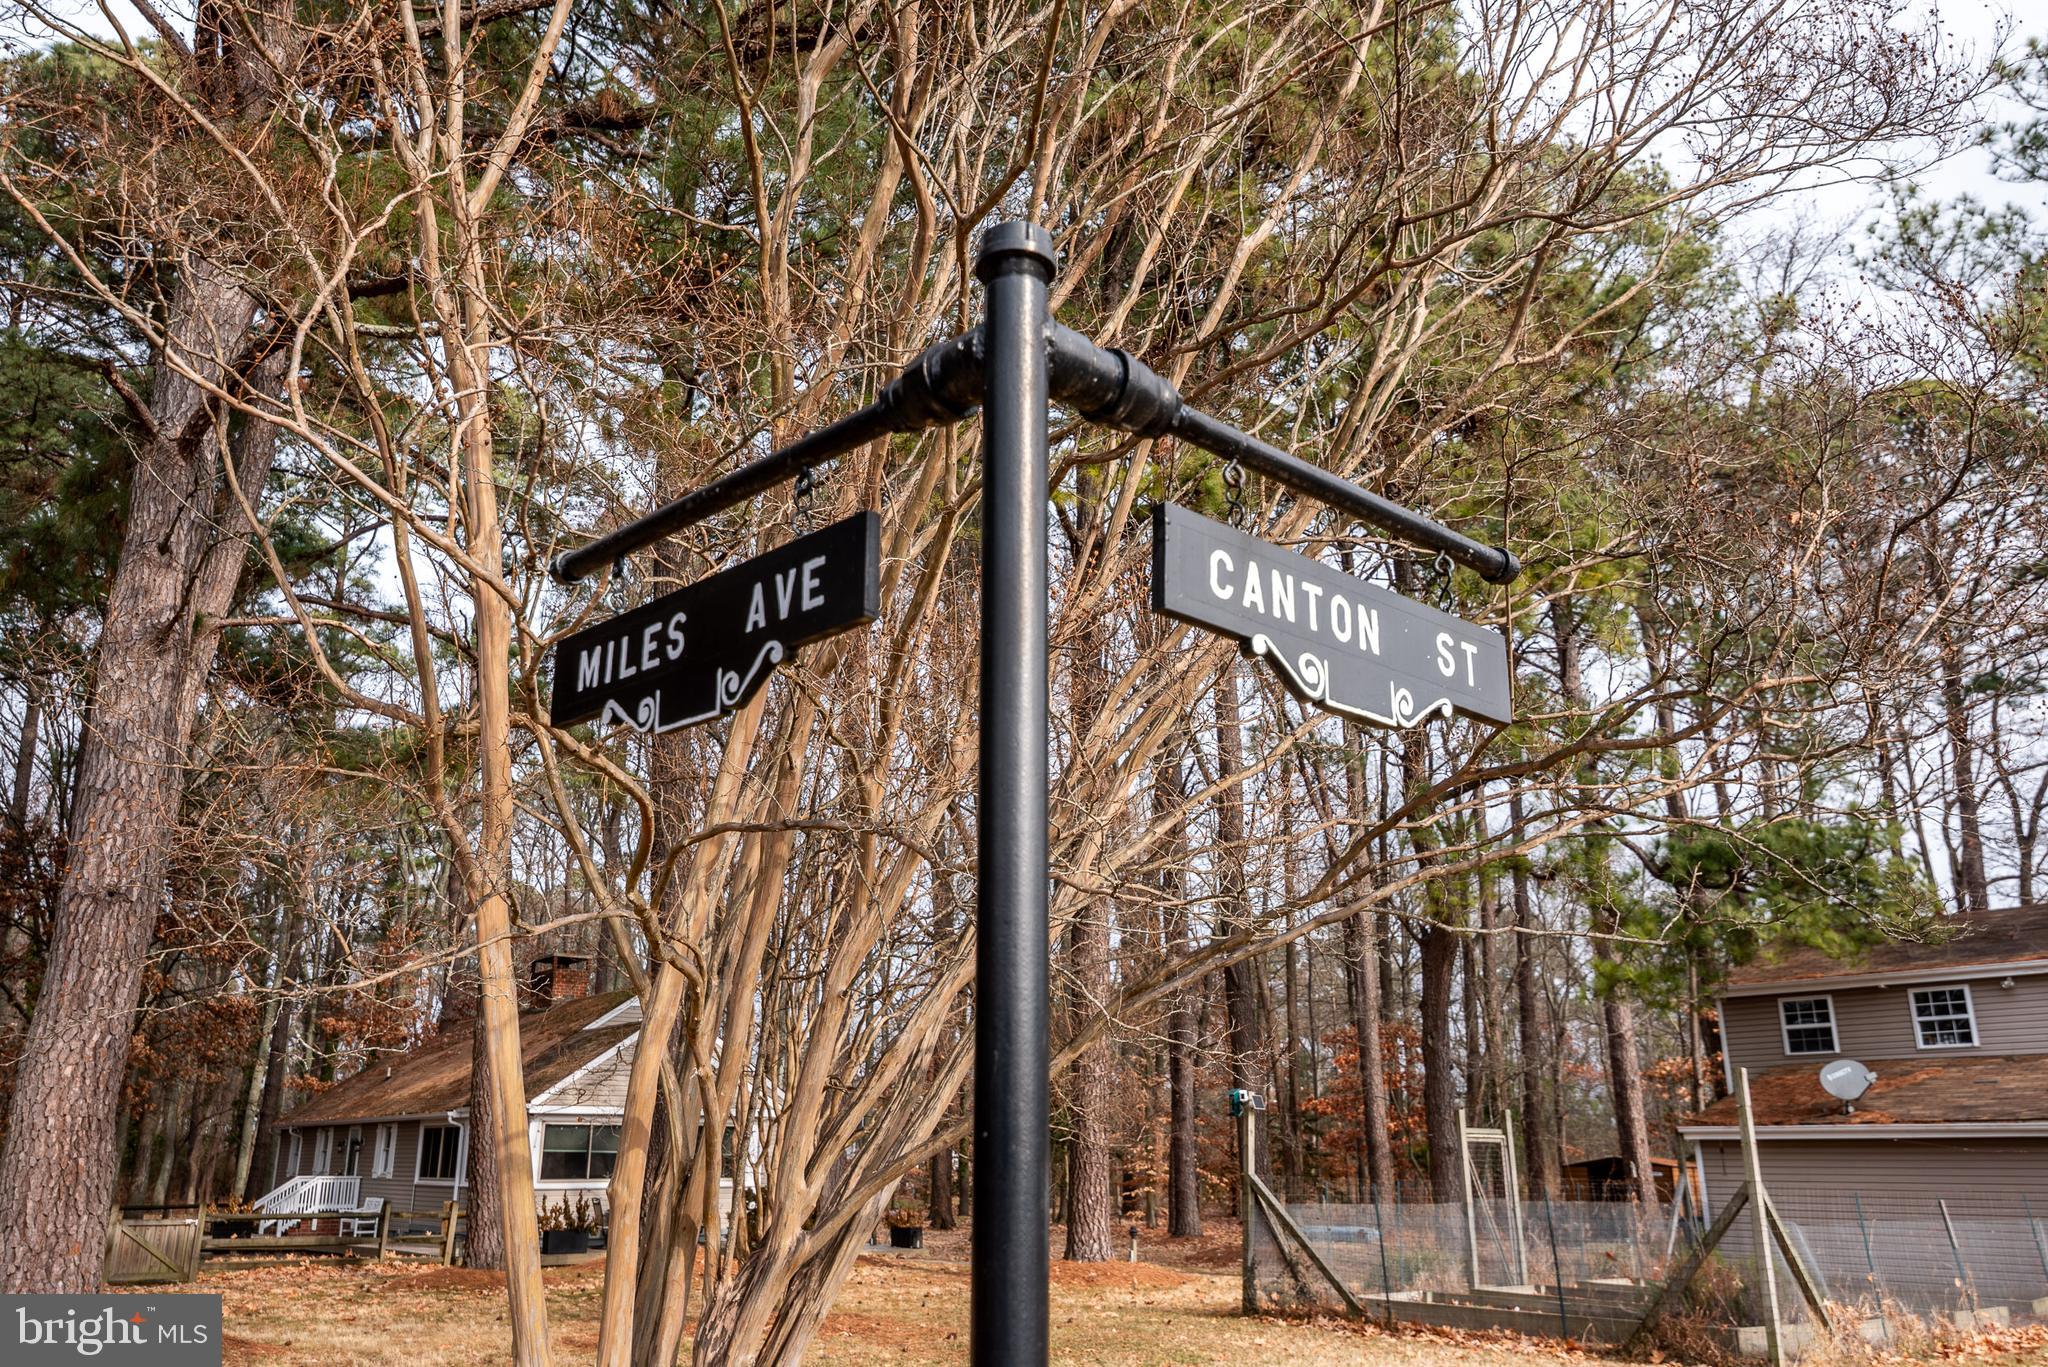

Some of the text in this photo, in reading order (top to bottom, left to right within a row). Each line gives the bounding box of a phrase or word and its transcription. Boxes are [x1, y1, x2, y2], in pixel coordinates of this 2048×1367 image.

[577, 555, 826, 692] MILES AVE
[1209, 549, 1478, 687] CANTON ST
